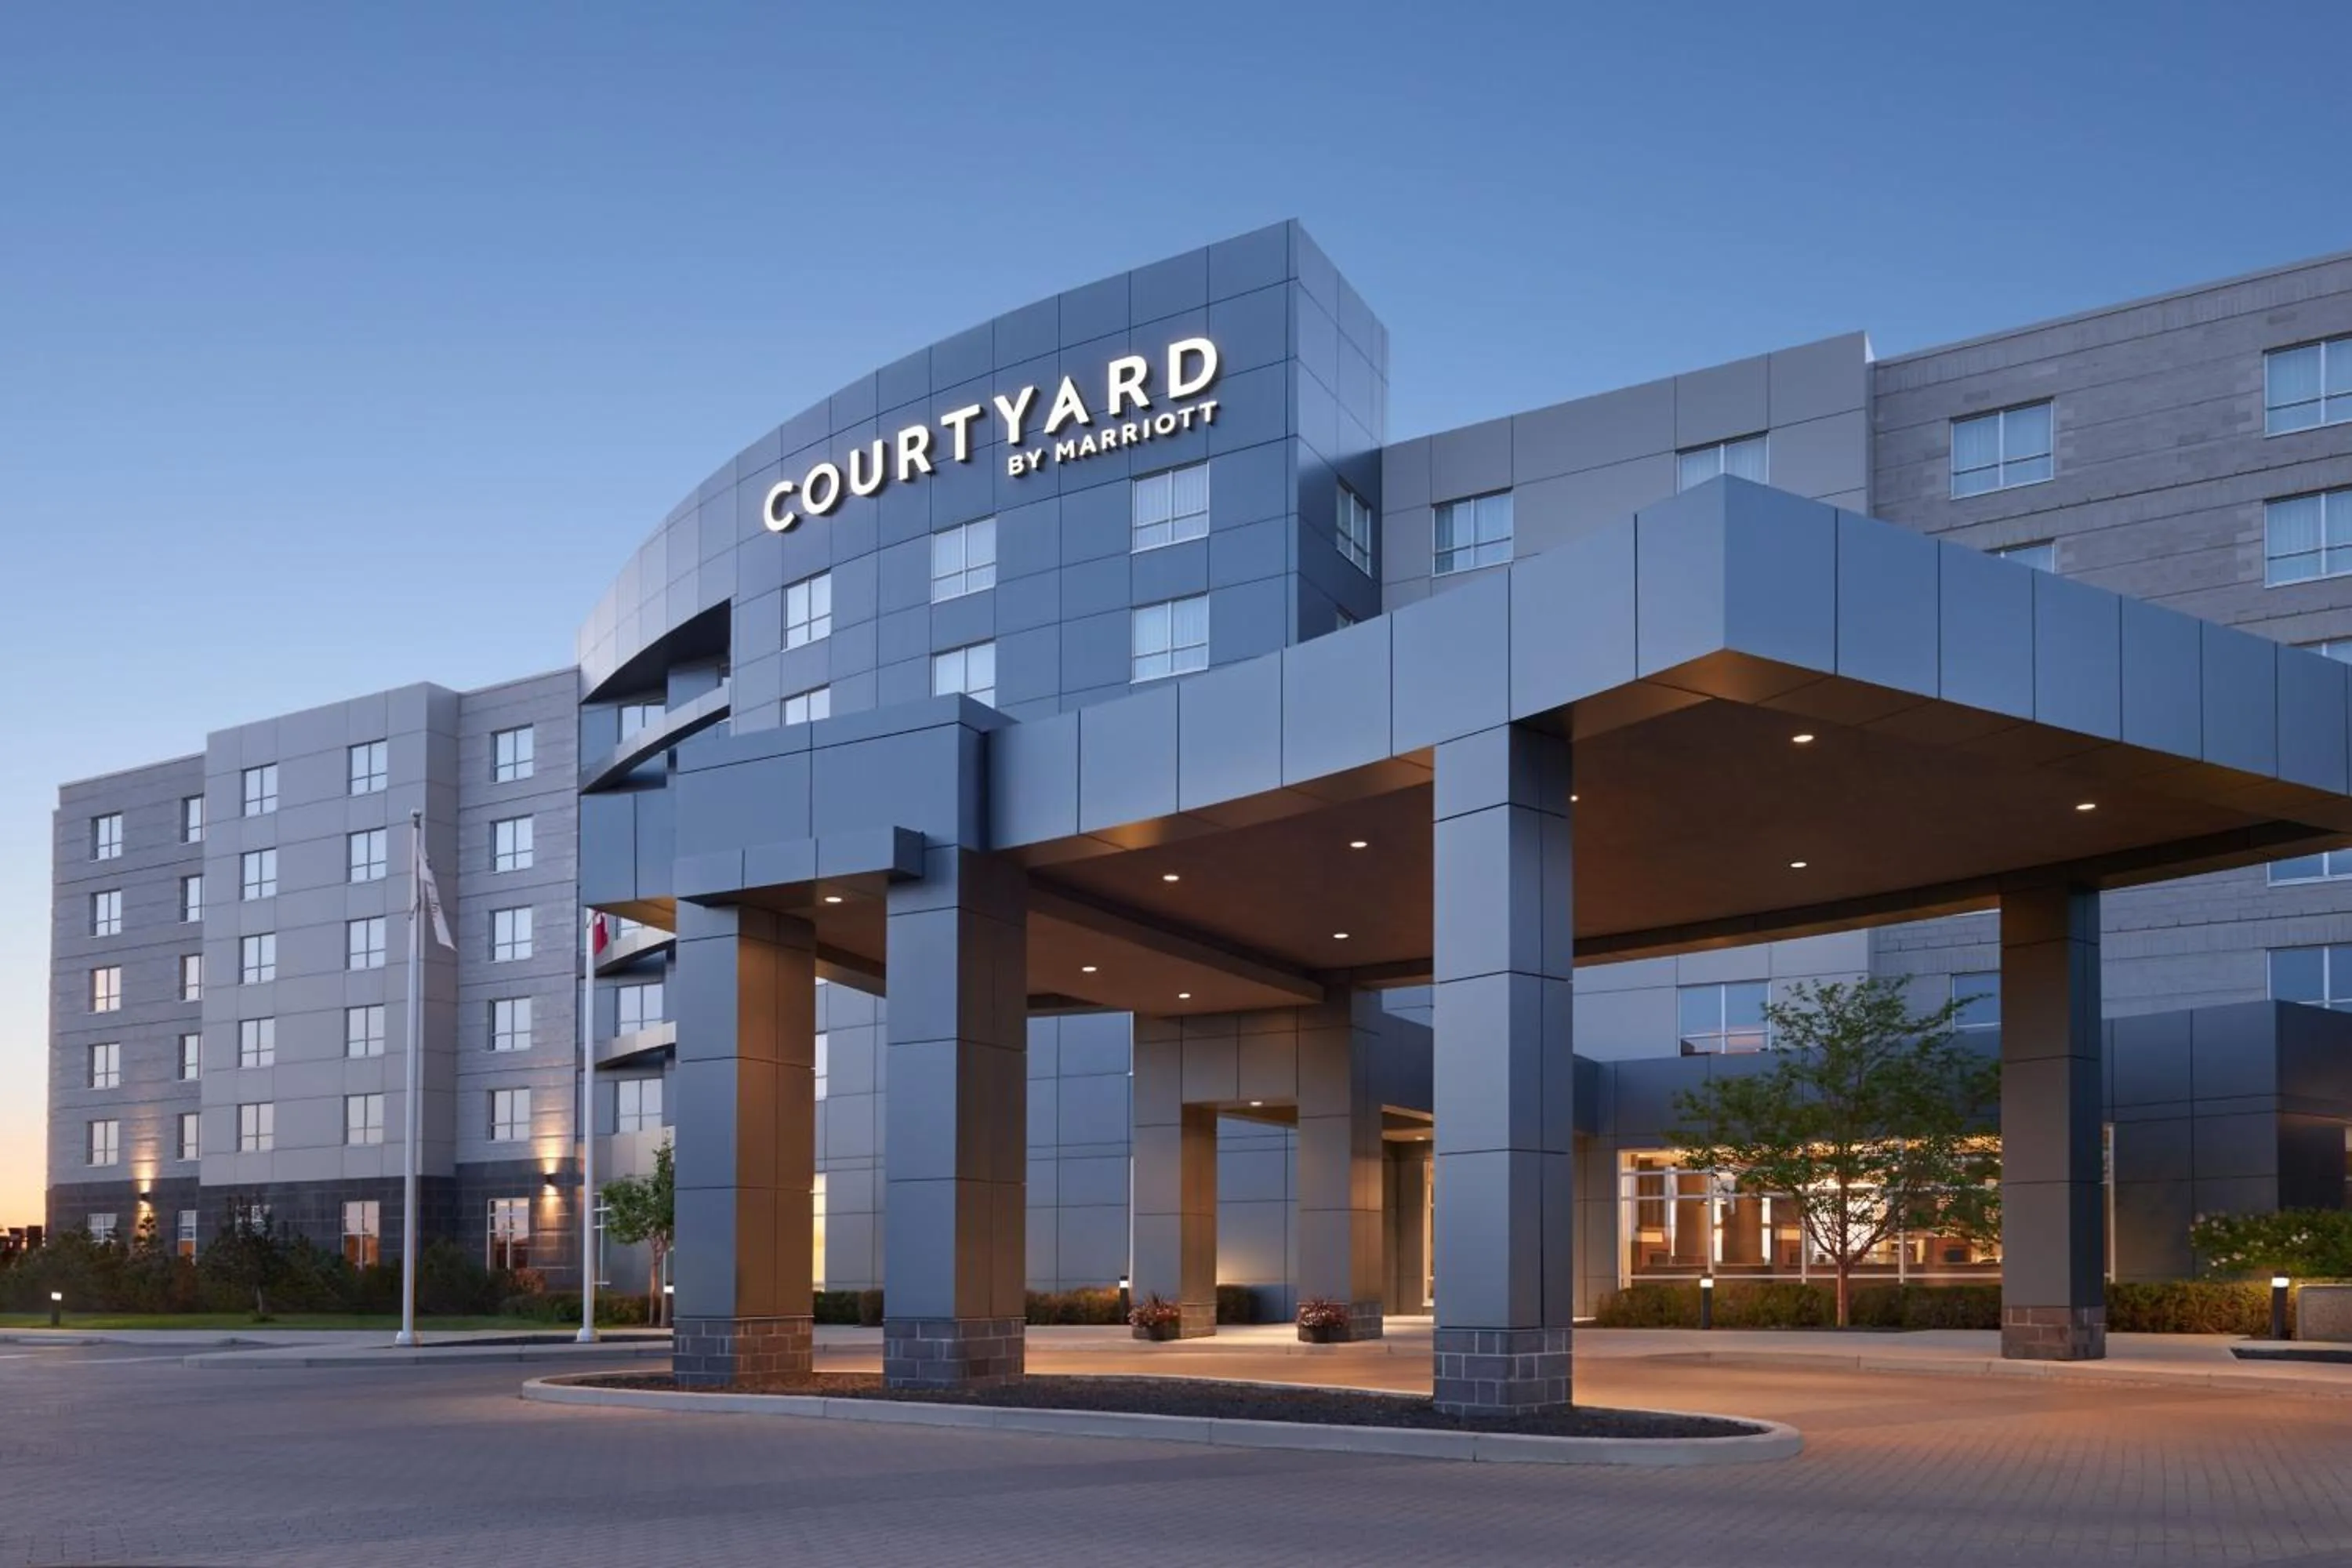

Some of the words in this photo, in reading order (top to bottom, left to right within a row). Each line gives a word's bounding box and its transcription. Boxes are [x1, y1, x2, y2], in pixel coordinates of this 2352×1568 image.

[763, 337, 1219, 532] COURTYARD
[1007, 448, 1043, 477] BY
[1054, 401, 1218, 463] MARRIOTT
